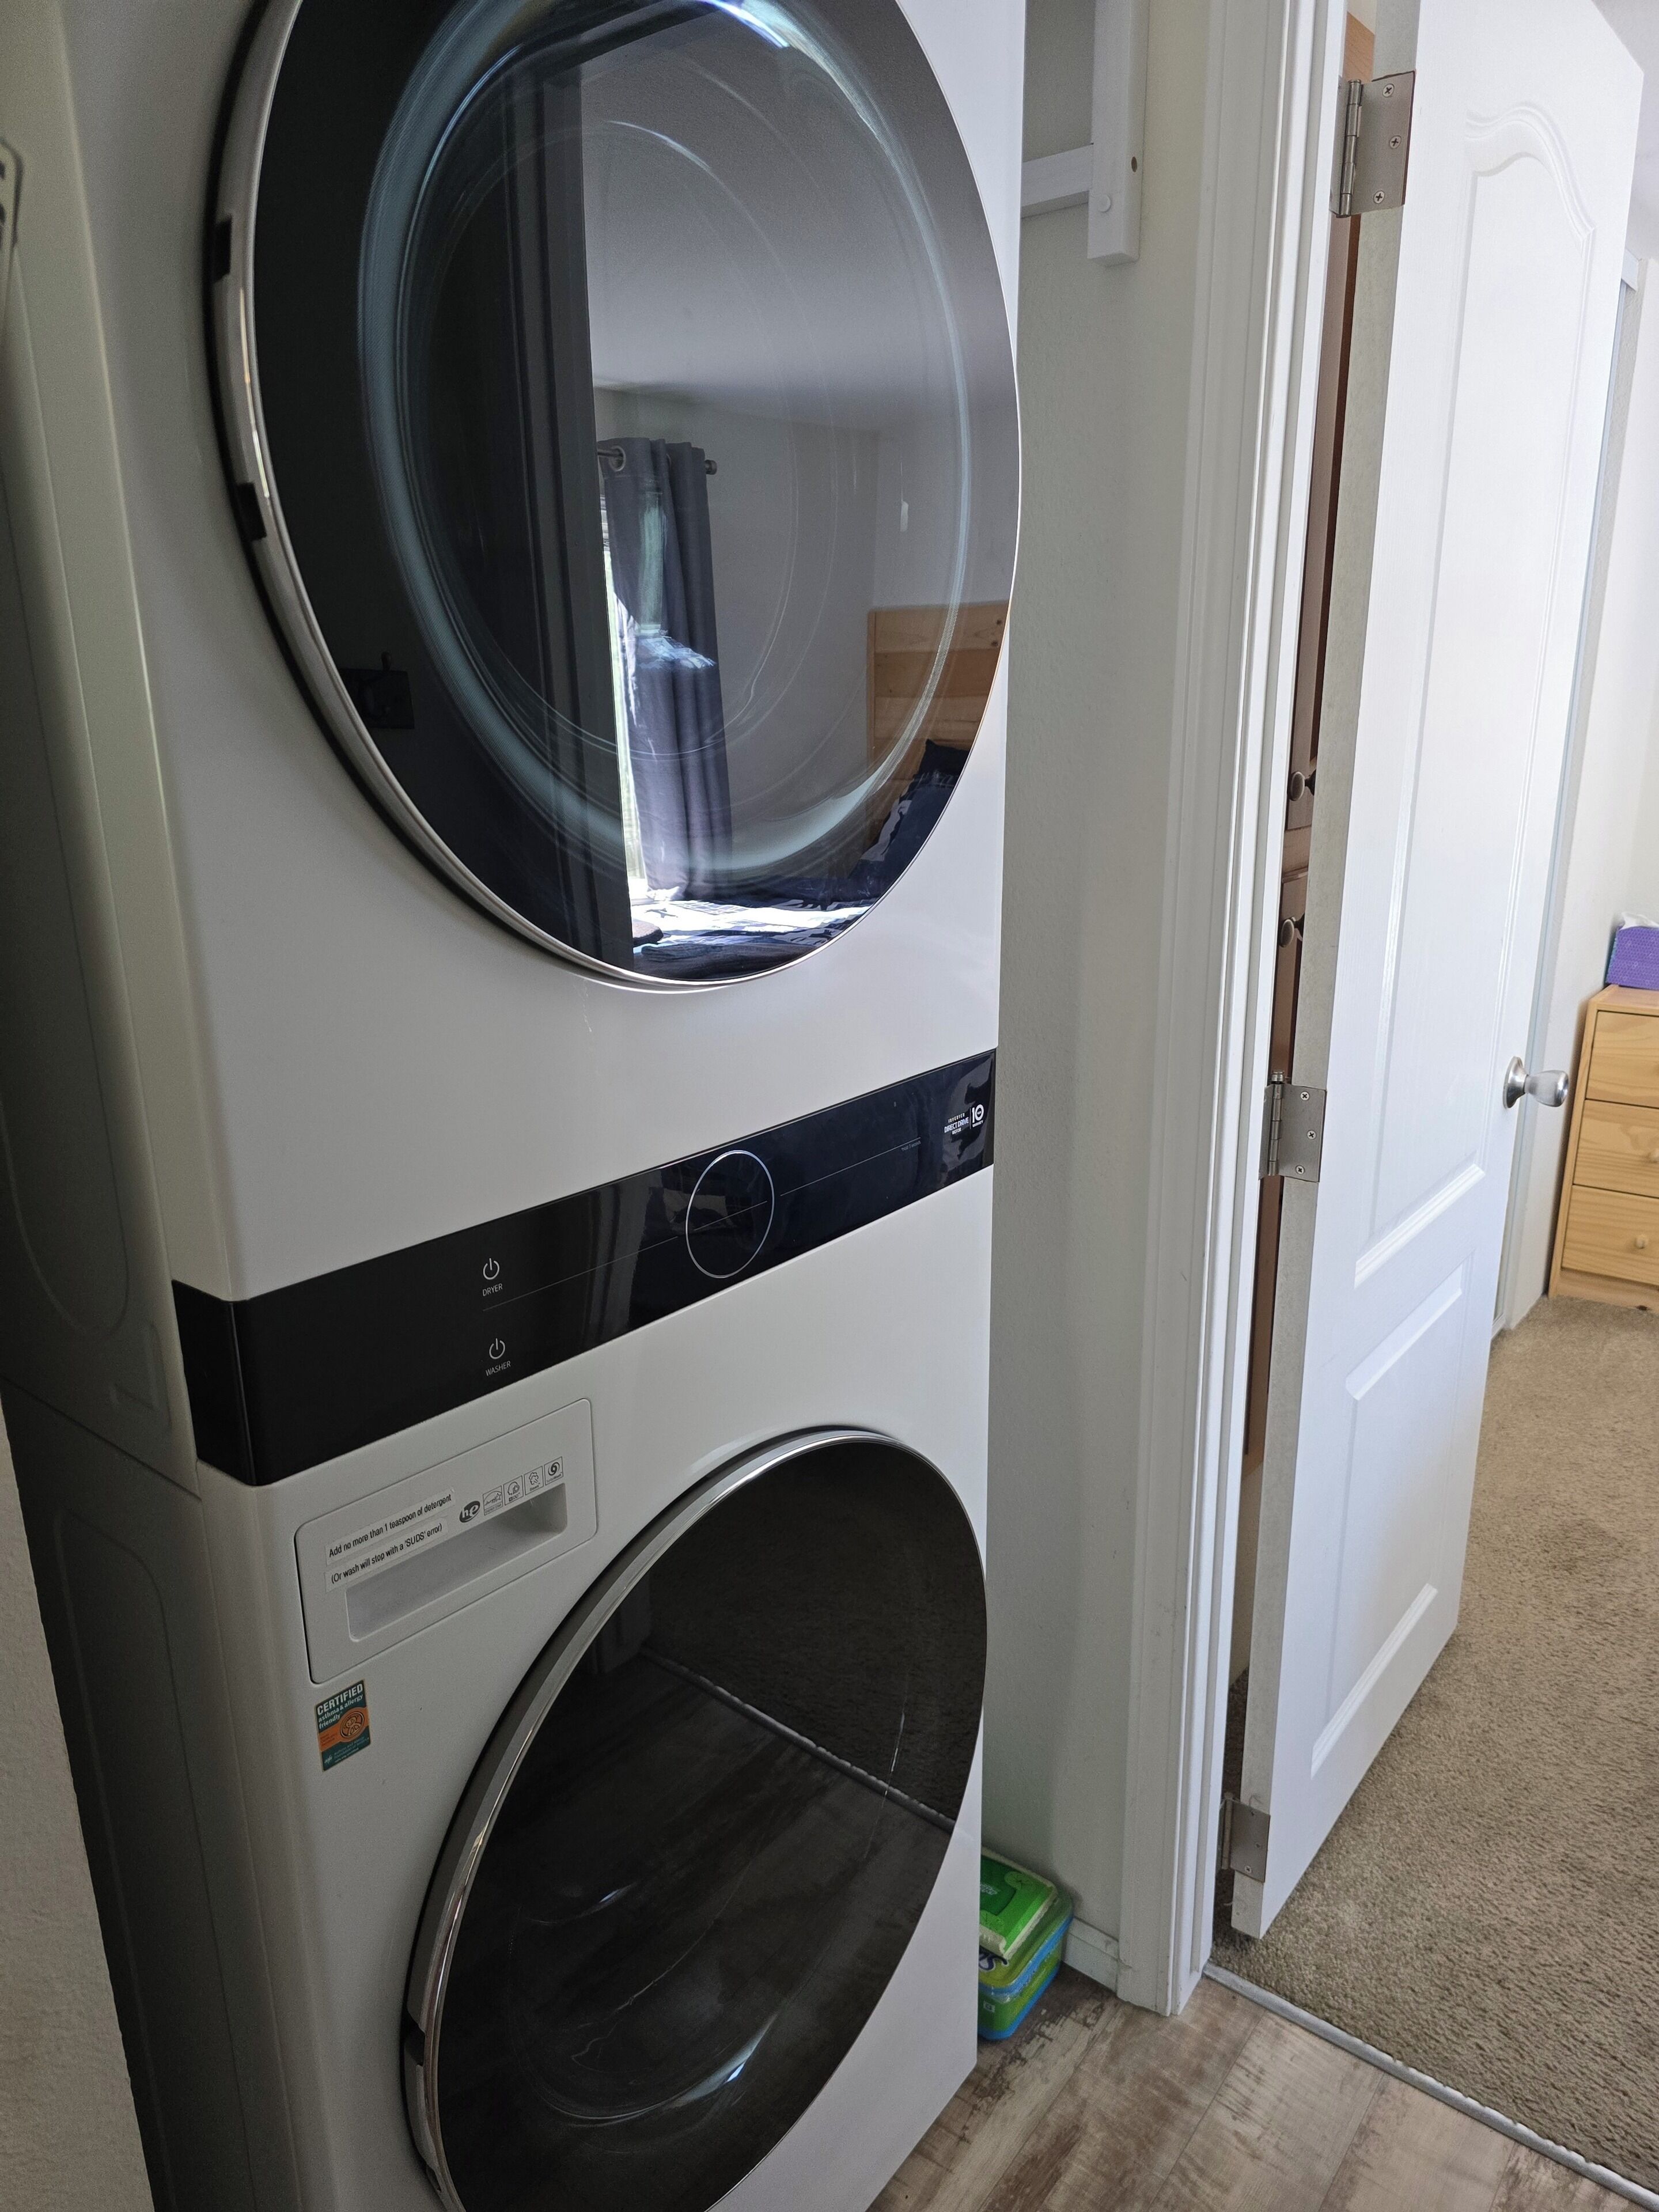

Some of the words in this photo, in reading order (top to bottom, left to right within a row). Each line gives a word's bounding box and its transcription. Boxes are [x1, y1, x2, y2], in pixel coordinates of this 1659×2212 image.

[972, 1104, 984, 1123] 10
[944, 1122, 957, 1133] DIRECT
[482, 1283, 503, 1297] DRYER
[485, 1361, 512, 1377] WASHER
[329, 1546, 342, 1558] Add
[343, 1543, 351, 1552] no
[353, 1534, 369, 1547] more
[370, 1527, 383, 1539] than
[385, 1523, 388, 1531] 1
[389, 1512, 416, 1529] teaspoon
[417, 1506, 423, 1516] of
[424, 1494, 452, 1513] detergent
[331, 1571, 342, 1584] (Or
[343, 1564, 359, 1578] wash
[360, 1558, 370, 1569] will
[372, 1552, 385, 1565] stop
[385, 1545, 398, 1557] with
[404, 1531, 426, 1547] 'SUDS'
[426, 1522, 442, 1537] error)
[317, 1683, 363, 1715] CERTIFIED
[319, 1707, 339, 1722] asthma
[344, 1694, 363, 1709] allergy
[319, 1713, 340, 1729] friendly
